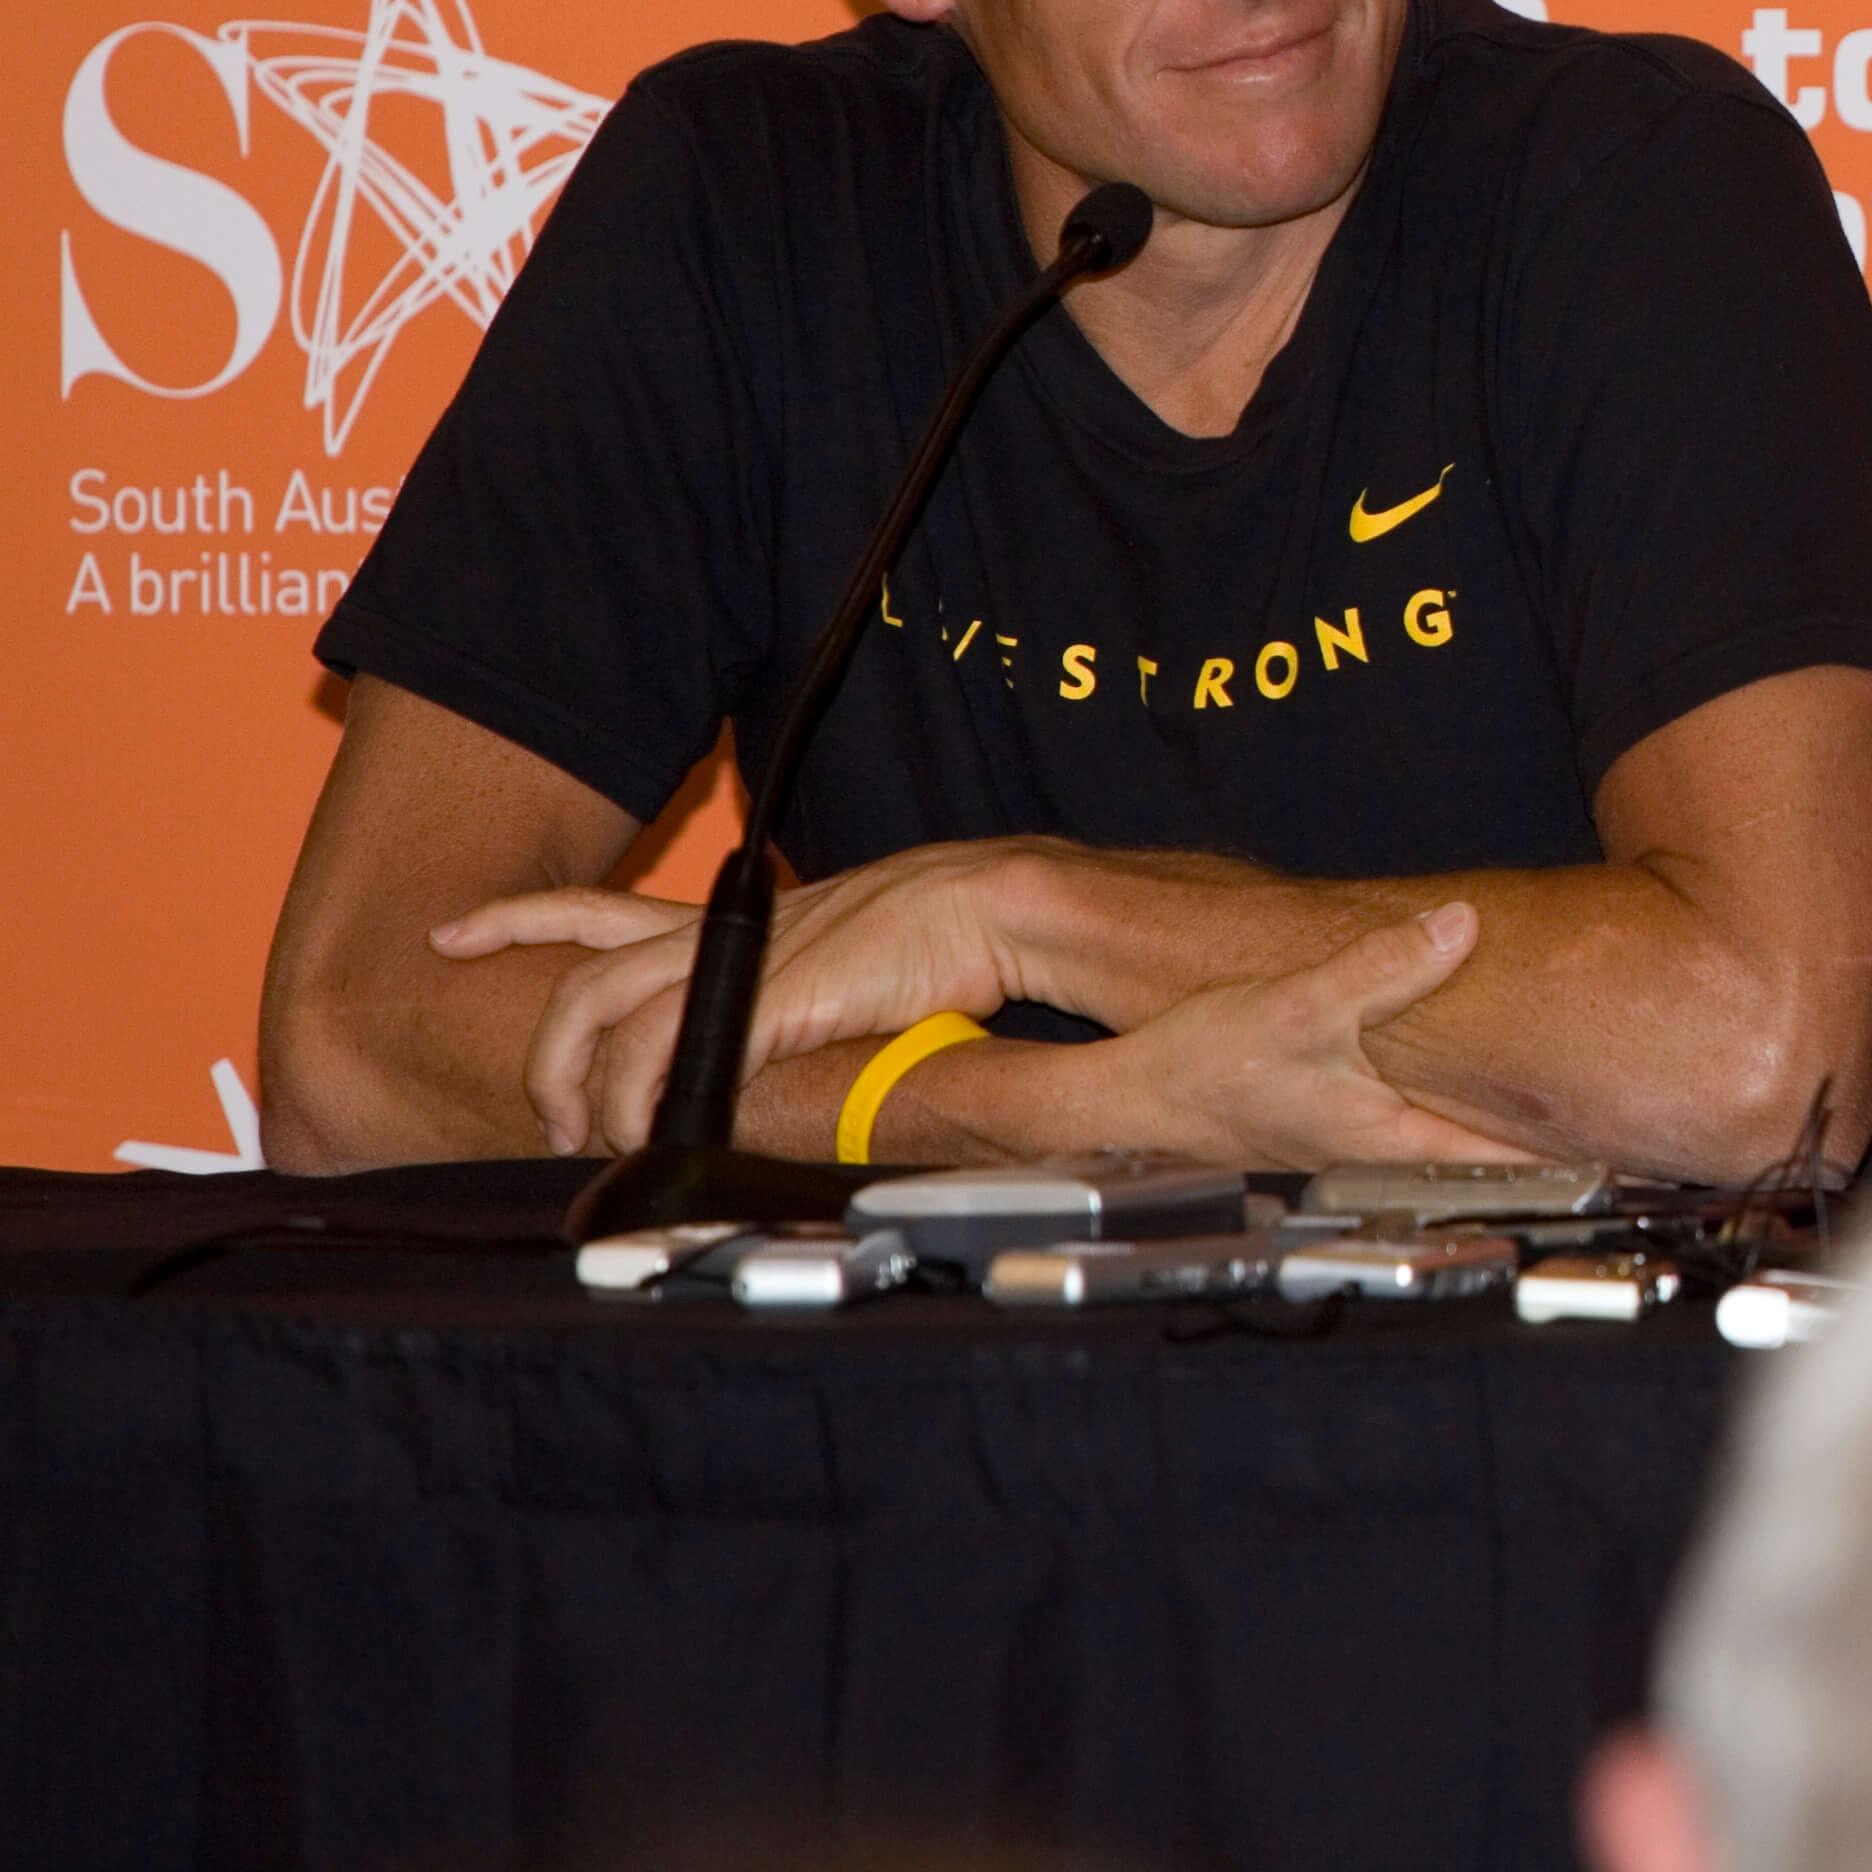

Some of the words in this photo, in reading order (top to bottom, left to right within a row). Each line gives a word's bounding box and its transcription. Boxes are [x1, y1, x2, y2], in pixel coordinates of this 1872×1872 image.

[69, 469, 254, 533] South
[66, 554, 111, 613] A
[131, 552, 365, 615] brillian
